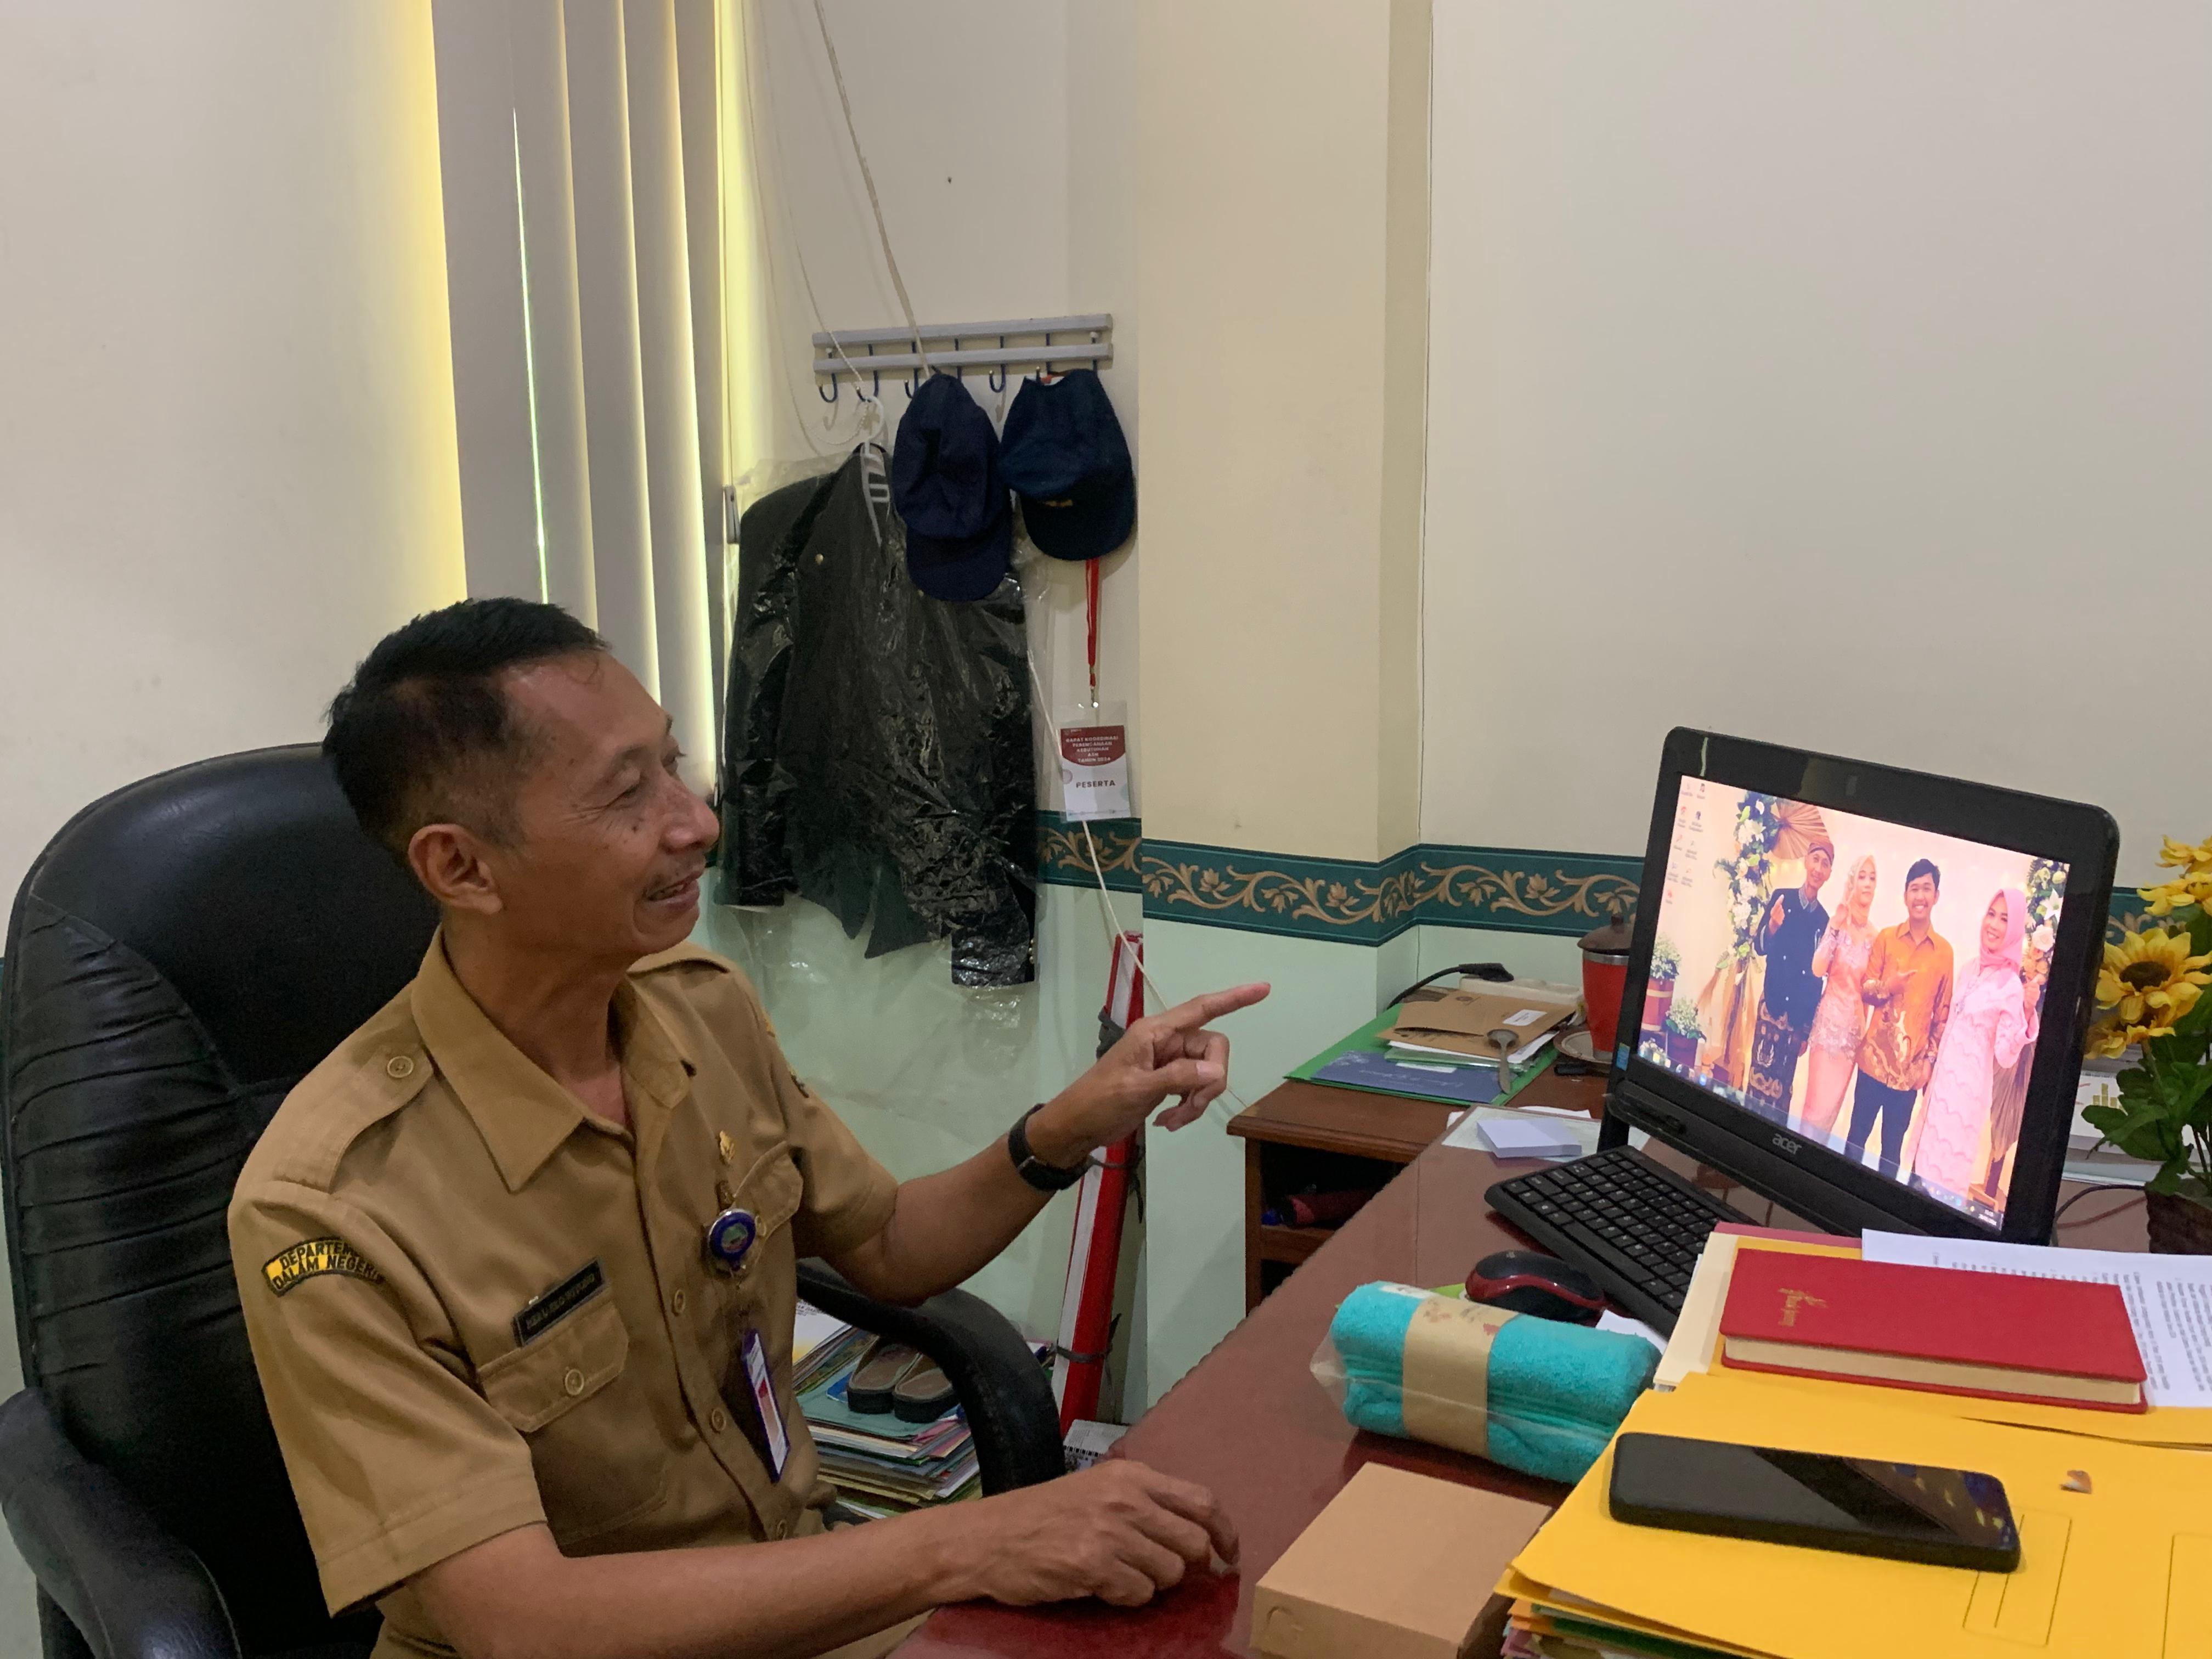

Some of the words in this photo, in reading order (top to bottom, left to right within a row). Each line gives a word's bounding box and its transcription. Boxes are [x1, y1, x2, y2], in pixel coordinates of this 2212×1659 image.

[1076, 780, 1116, 788] PESERTA
[1772, 1133, 1802, 1154] acer
[279, 1241, 358, 1271] DEPARTEM
[272, 1257, 319, 1289] DALAM
